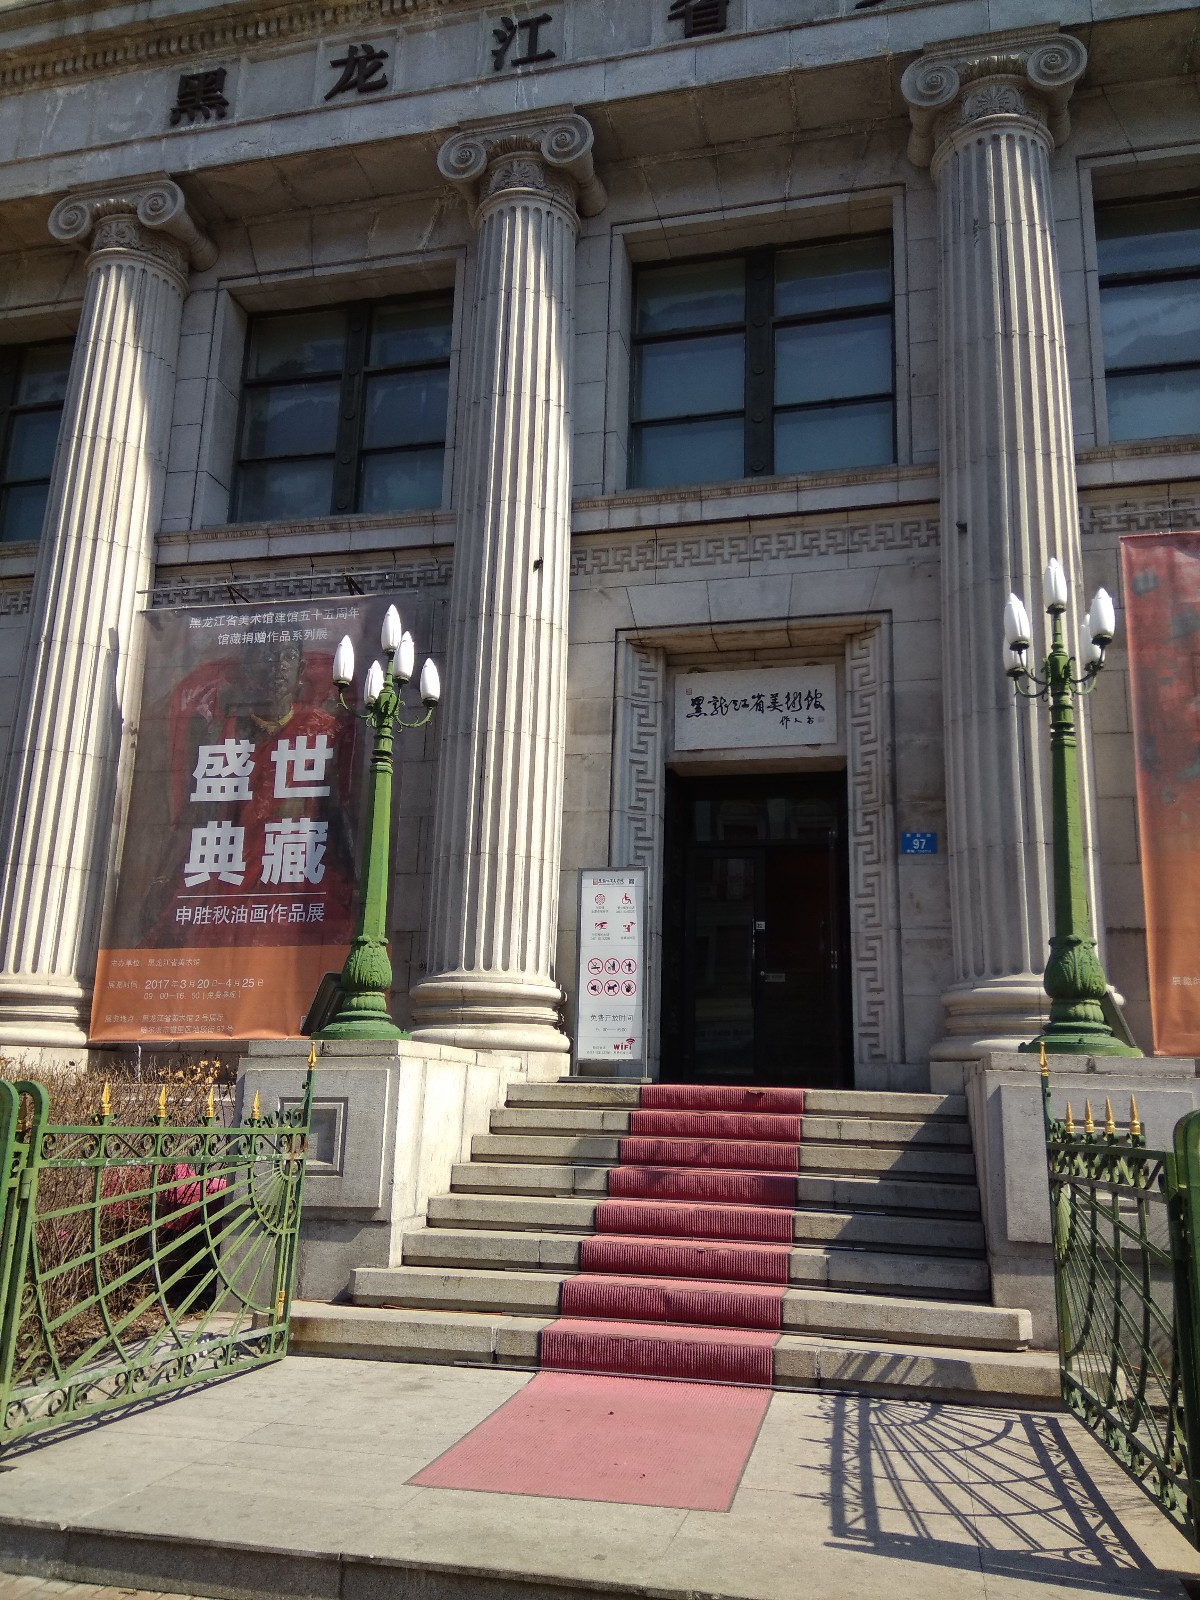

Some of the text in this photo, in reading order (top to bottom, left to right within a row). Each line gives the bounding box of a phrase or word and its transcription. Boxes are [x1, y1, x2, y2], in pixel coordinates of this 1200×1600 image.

[189, 607, 360, 629] 黑龙江省美术馆建馆五十五周年
[217, 628, 328, 646] 馆藏捐赠作品系列展
[190, 734, 334, 803] 盛世
[183, 817, 329, 888] 典藏
[912, 838, 926, 849] 97
[175, 901, 325, 925] 申胜秋油画作品展
[590, 1014, 634, 1022] 免费开放时间
[613, 1042, 632, 1050] WiFi
